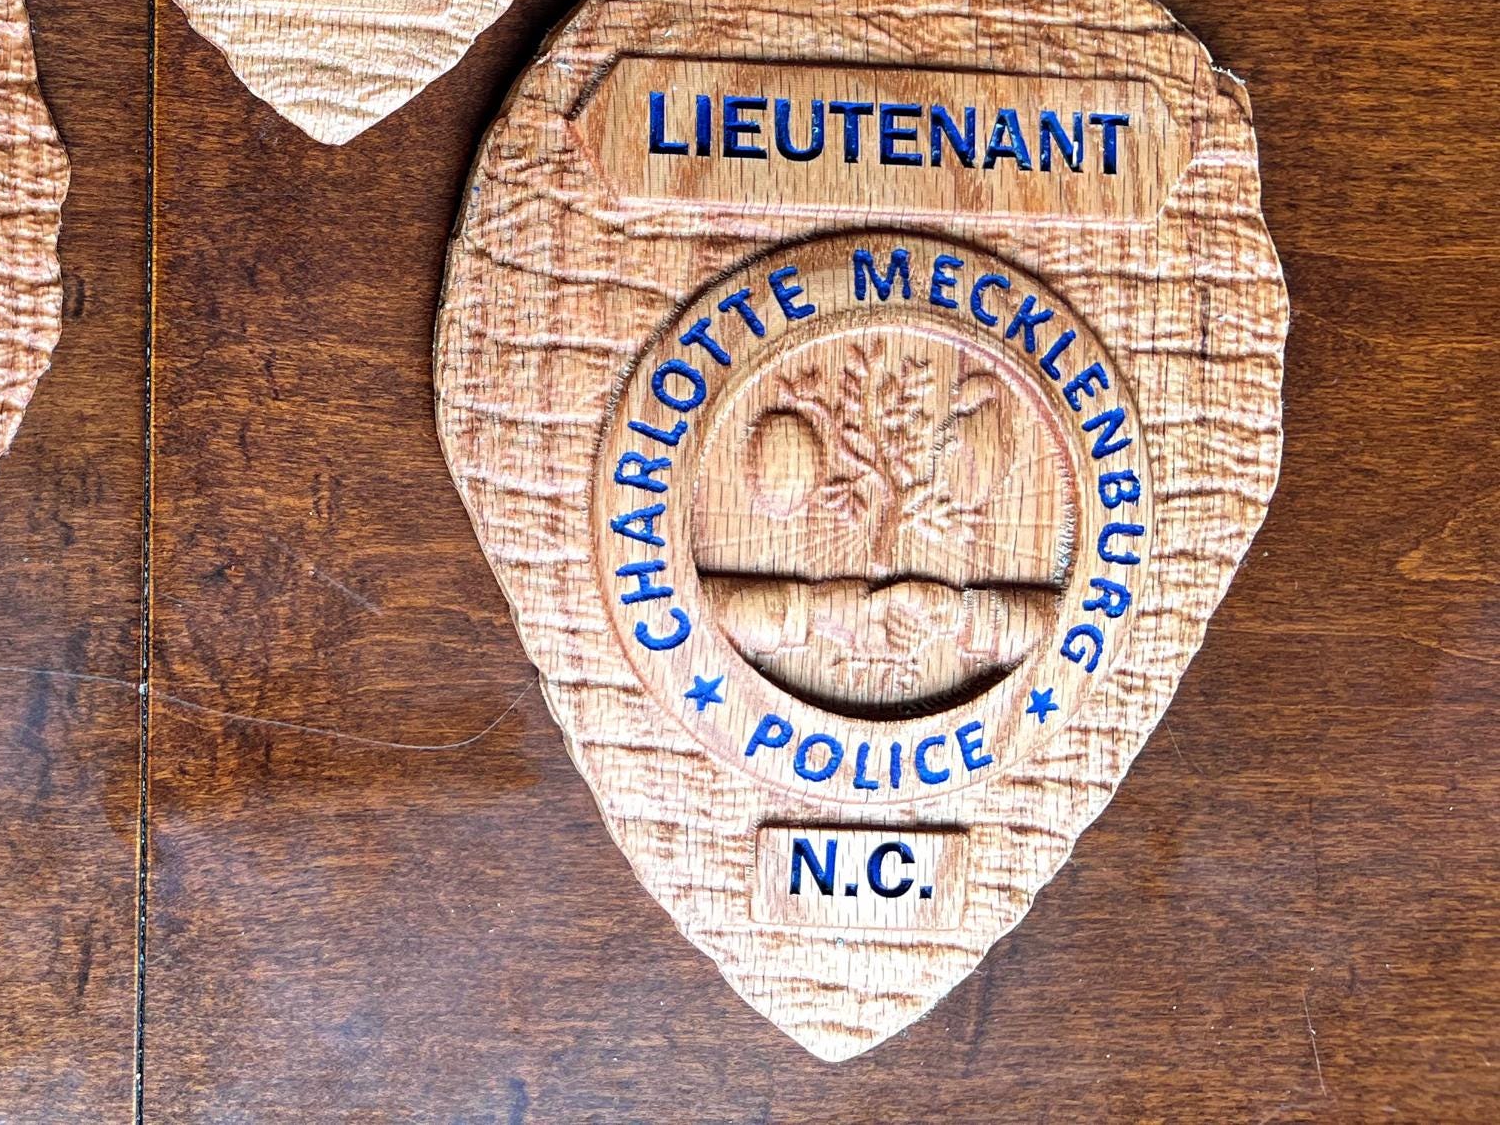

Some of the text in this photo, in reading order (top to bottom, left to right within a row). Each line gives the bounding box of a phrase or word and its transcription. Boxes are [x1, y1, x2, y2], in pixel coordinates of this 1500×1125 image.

[647, 90, 1133, 175] LIEUTENANT
[608, 246, 1148, 675] CHARLOTTE MECKLENBURG
[742, 711, 996, 796] POLICE
[786, 833, 936, 902] N.C.
